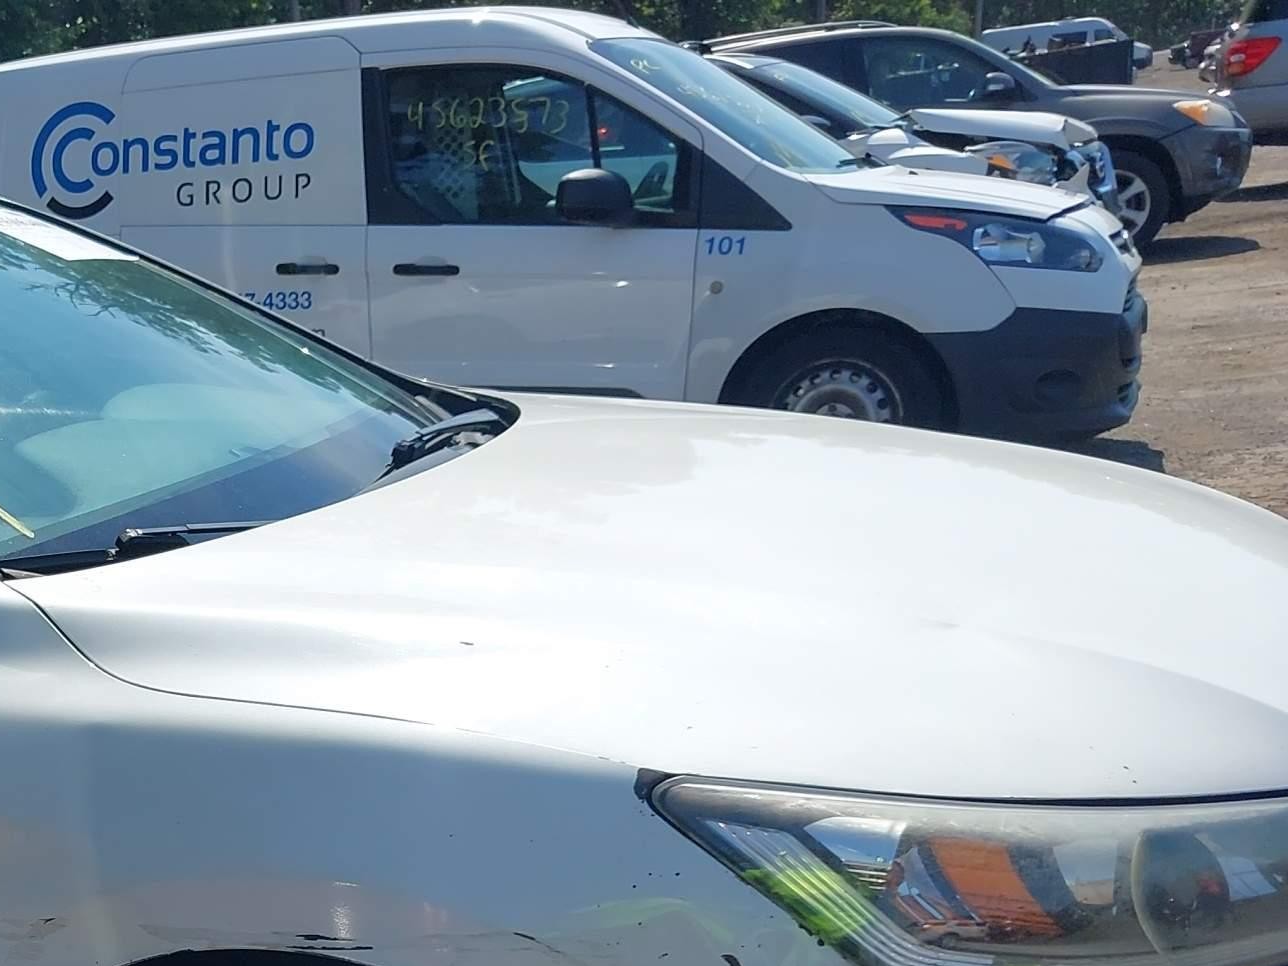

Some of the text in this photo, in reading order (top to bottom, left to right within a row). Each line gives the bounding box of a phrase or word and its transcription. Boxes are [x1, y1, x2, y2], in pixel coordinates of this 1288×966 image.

[50, 119, 315, 194] Constanto
[176, 172, 312, 207] GROUP
[705, 236, 746, 255] 101
